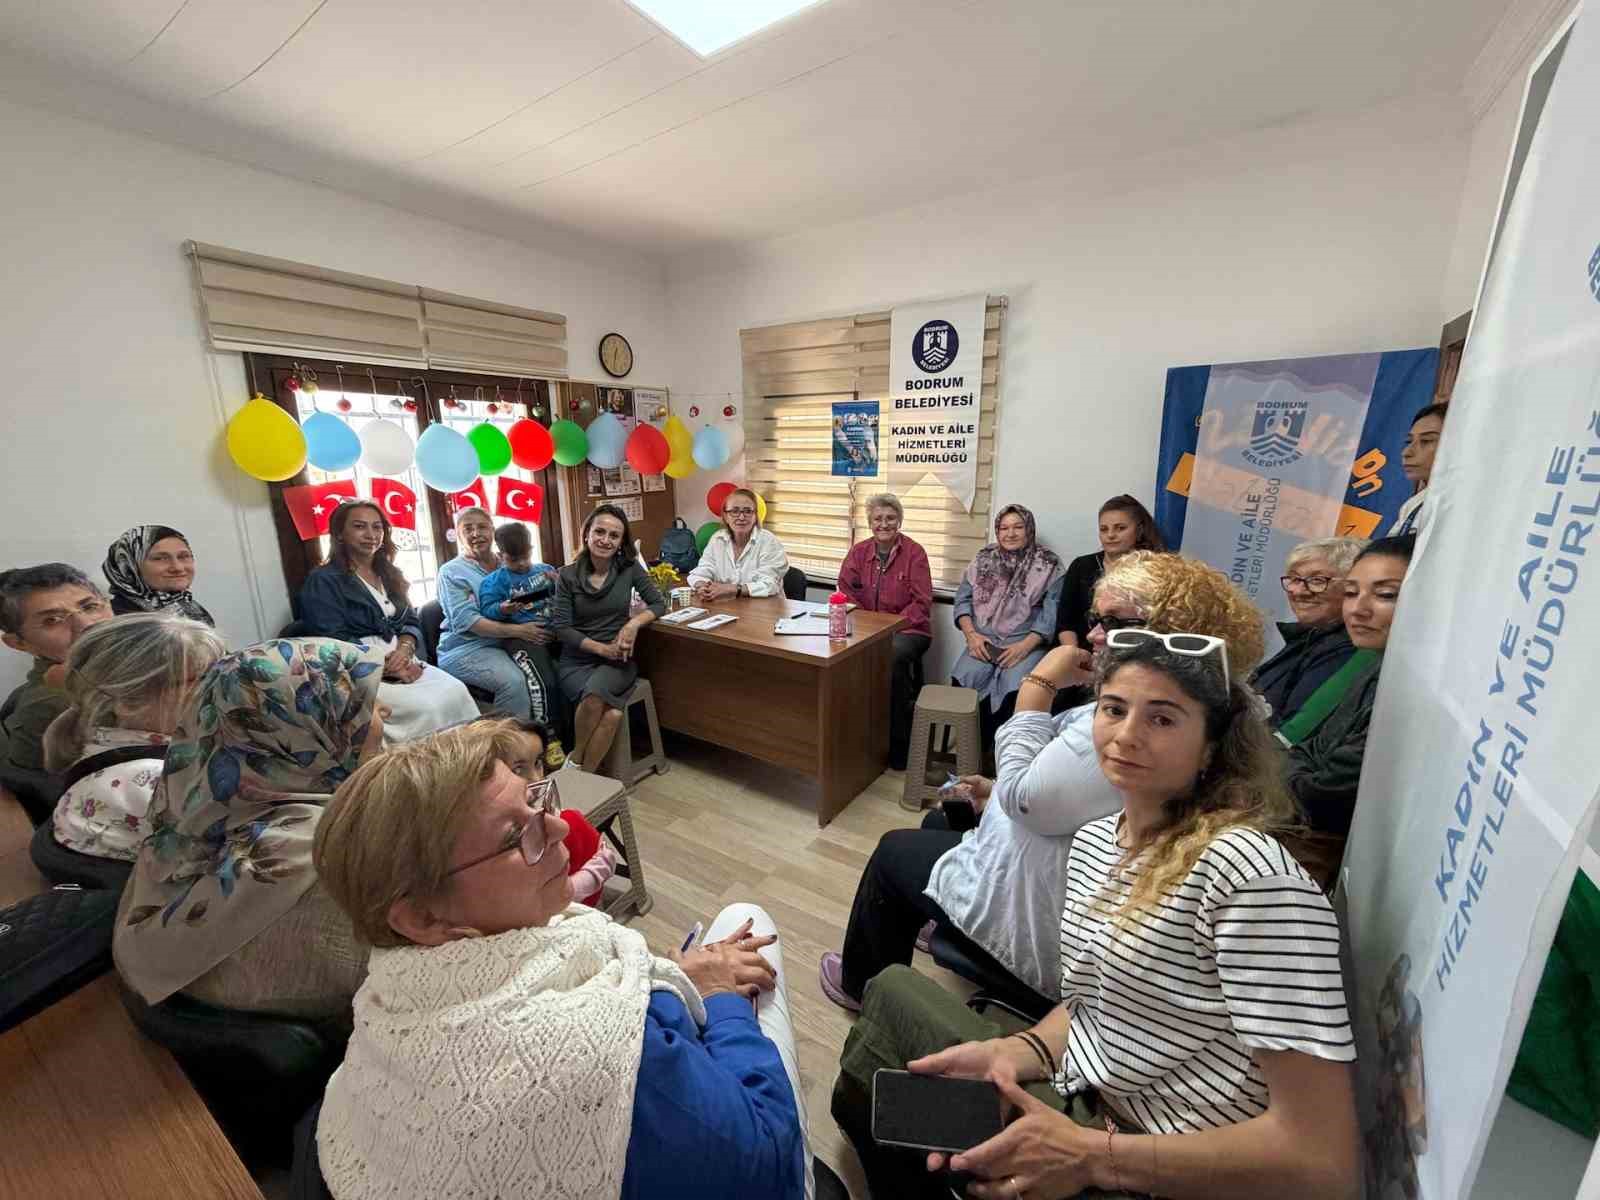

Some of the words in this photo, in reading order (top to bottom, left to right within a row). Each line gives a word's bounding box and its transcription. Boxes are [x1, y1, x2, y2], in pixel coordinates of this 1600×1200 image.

[905, 377, 963, 390] BODRUM
[895, 393, 973, 408] BELEDİYESİ
[1256, 401, 1308, 409] BODRUM
[892, 425, 926, 435] KADIN
[929, 424, 944, 434] VE
[948, 422, 975, 434] AİLE
[898, 438, 966, 448] HİZMETLERİ
[896, 452, 967, 463] MÜDÜRLÜĞÜ
[1237, 532, 1253, 555] VE
[1231, 557, 1248, 583] DIN
[1434, 717, 1493, 902] KADIN
